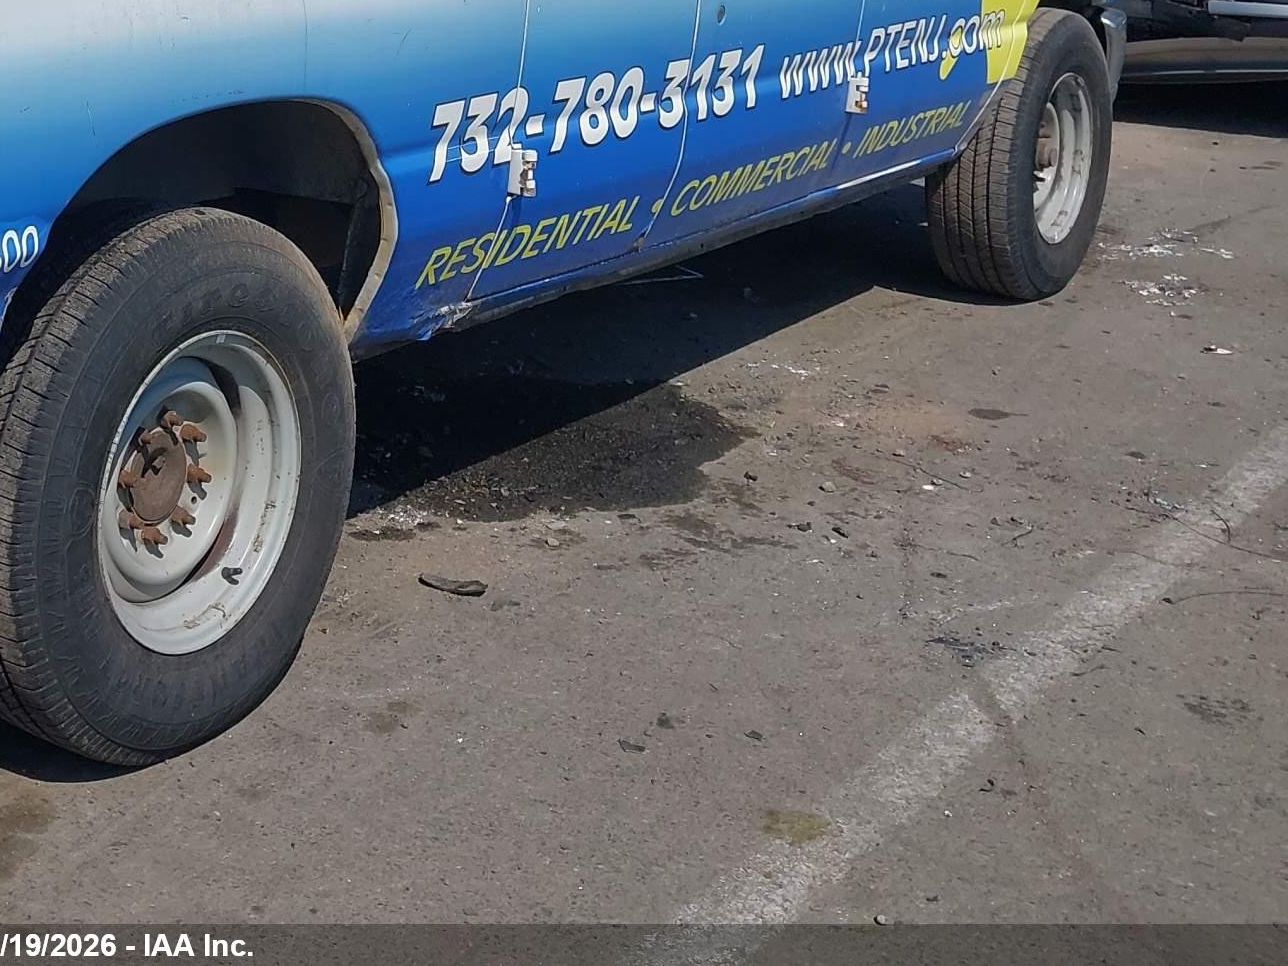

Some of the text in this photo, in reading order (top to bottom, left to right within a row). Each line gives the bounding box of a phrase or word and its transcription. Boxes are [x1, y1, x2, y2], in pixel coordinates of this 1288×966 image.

[415, 99, 972, 290] RESIDENTIAL COMMERCIAL INDUSTRIAL
[428, 42, 766, 184] 732-780-3131
